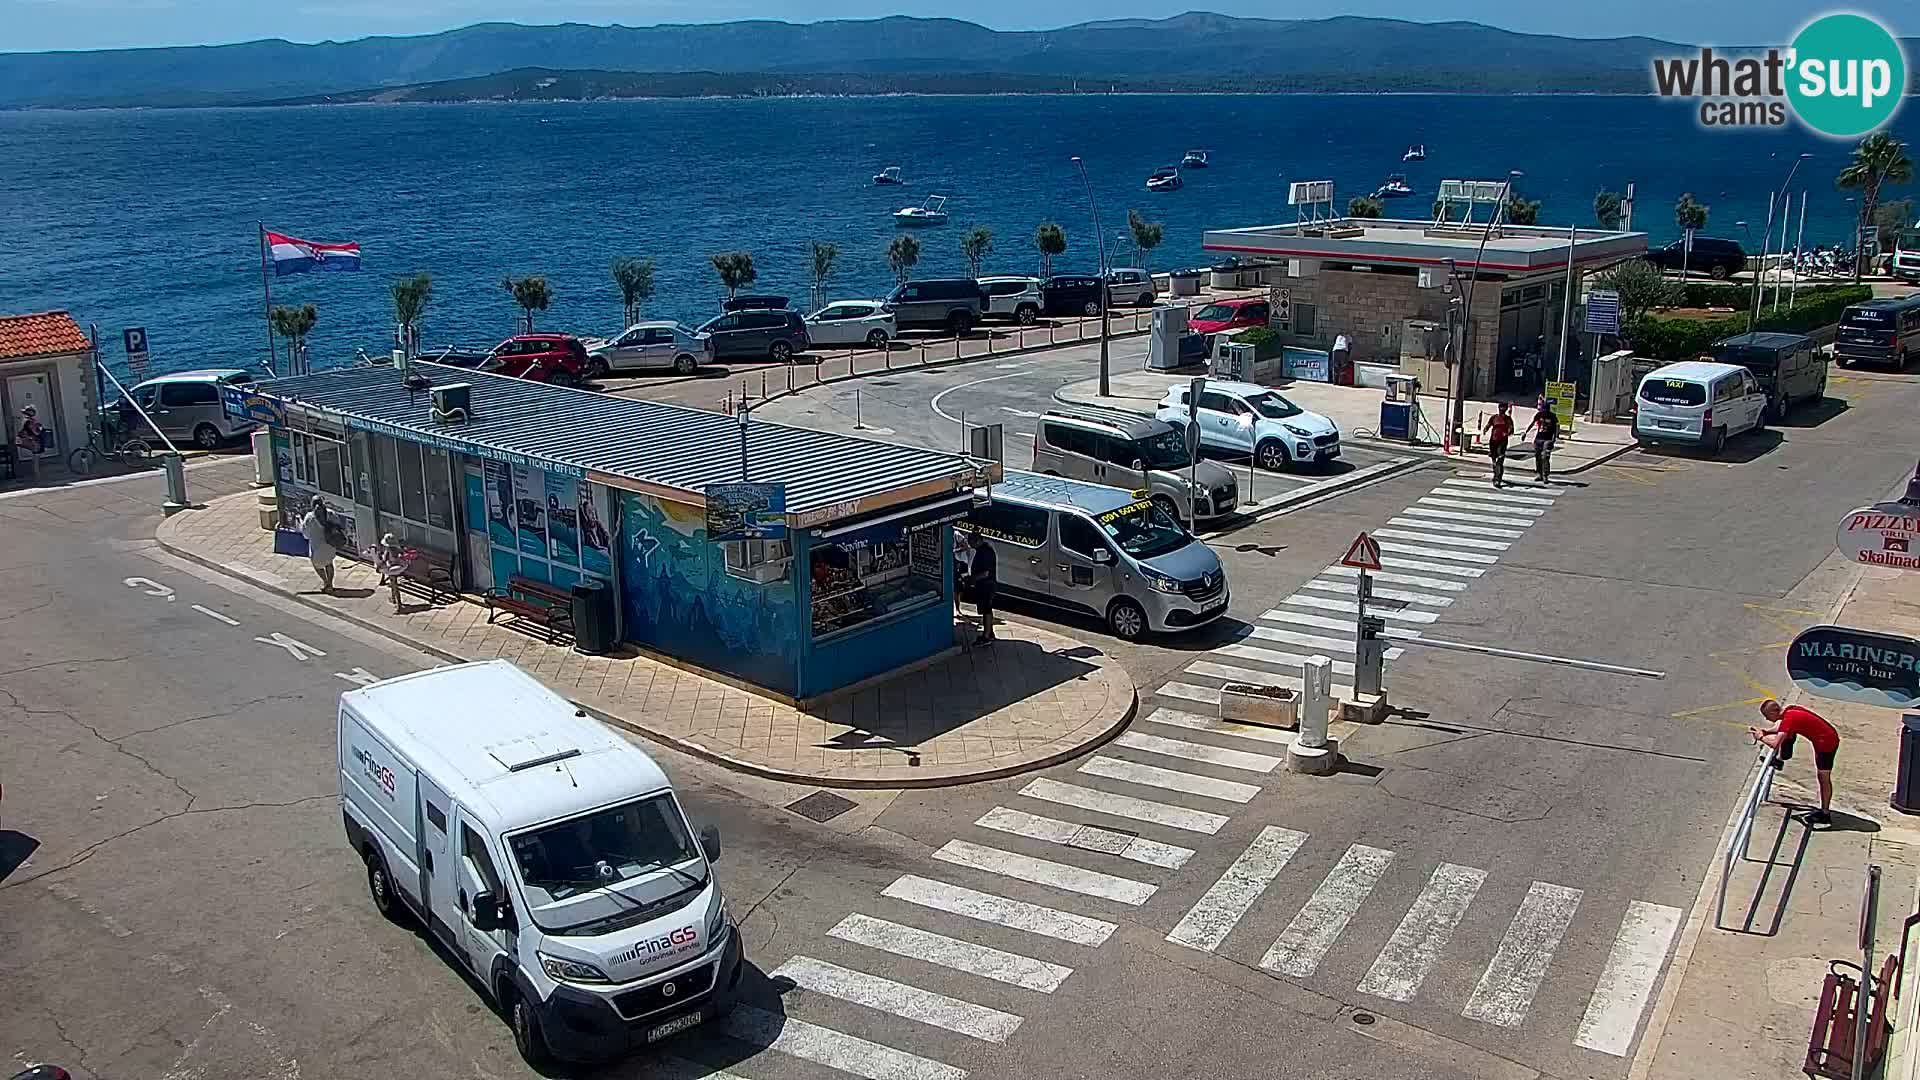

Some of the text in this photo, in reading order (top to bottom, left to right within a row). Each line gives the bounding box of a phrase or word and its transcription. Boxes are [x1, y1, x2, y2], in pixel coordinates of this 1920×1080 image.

[130, 331, 141, 350] P
[1665, 380, 1685, 389] TAXI
[477, 447, 492, 459] BUS
[493, 450, 525, 466] STATION
[527, 457, 553, 471] TICKET
[554, 463, 582, 477] OFFICE
[1016, 535, 1039, 546] TAXI
[1828, 661, 1896, 680] caffe bar
[364, 750, 395, 791] FinaGS
[634, 925, 697, 958] FinaGS
